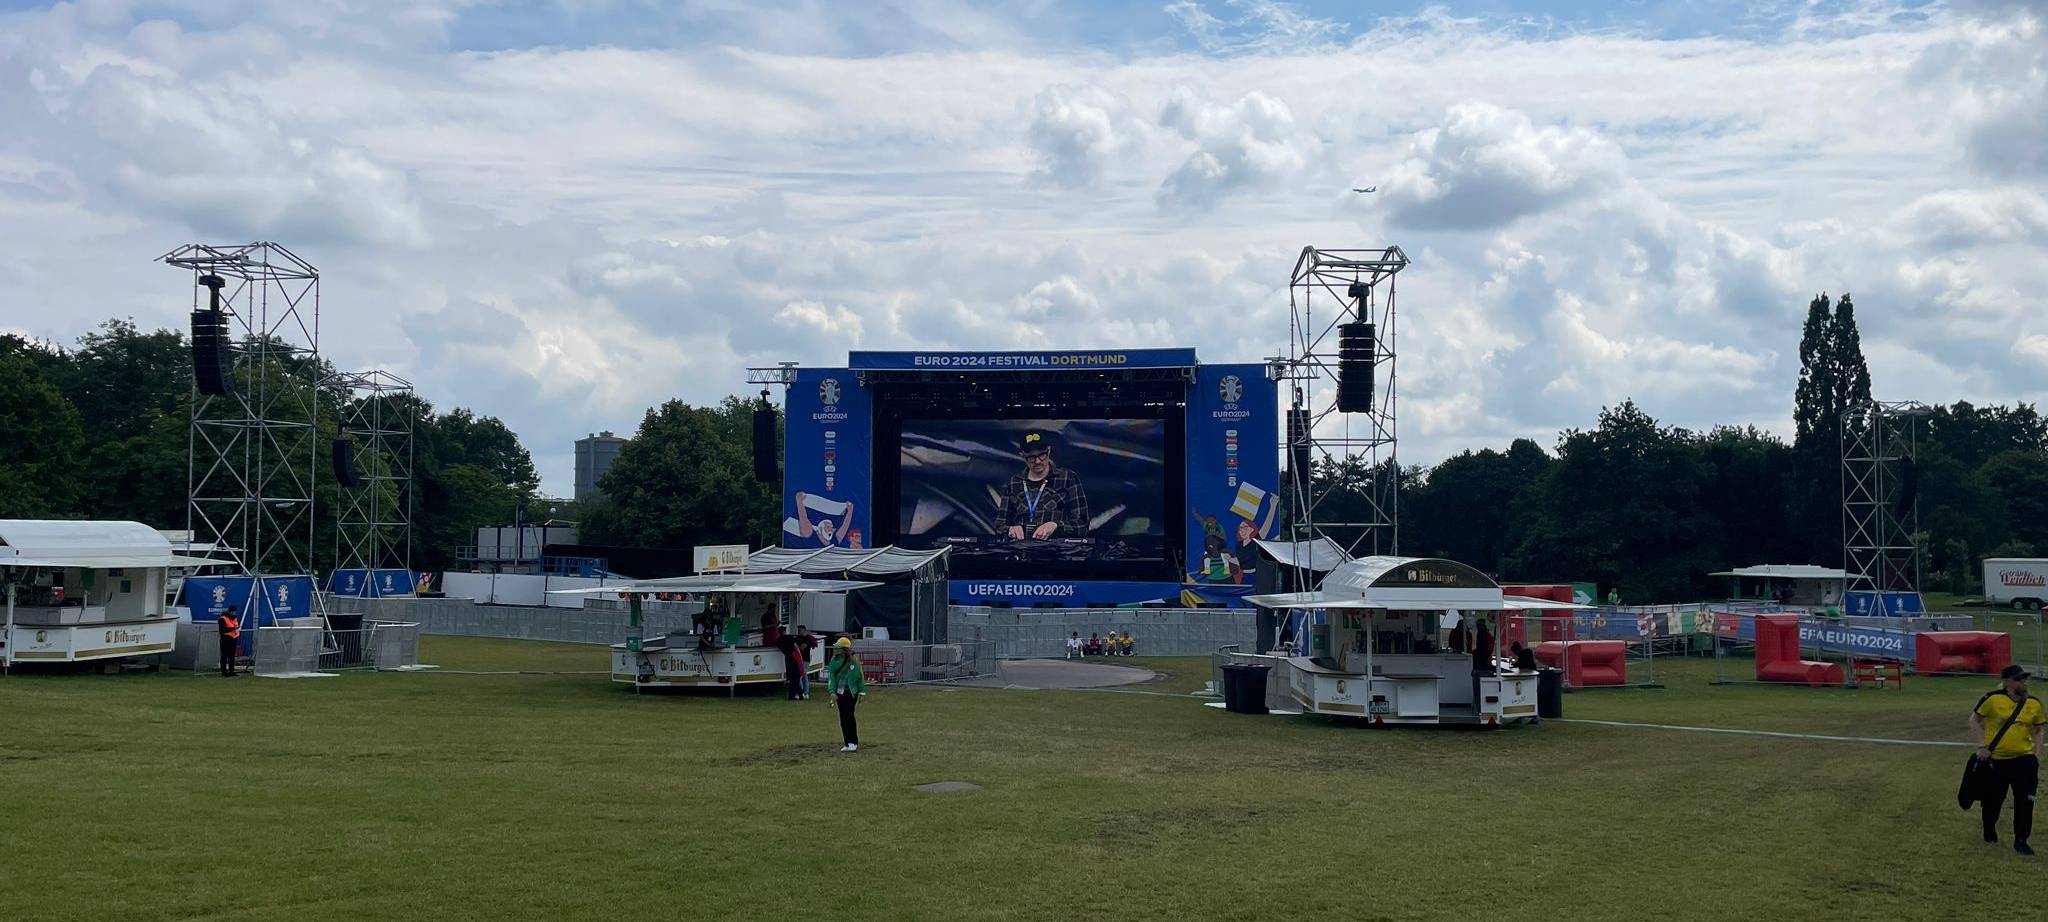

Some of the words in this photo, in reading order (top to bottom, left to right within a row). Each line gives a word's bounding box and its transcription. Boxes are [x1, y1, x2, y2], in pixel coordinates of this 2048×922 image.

[914, 355, 950, 366] EURO
[952, 355, 986, 366] 2024
[988, 355, 1048, 366] FESTIVAL
[1050, 354, 1127, 365] DORTMUND
[1212, 410, 1250, 418] EURO2024
[1418, 569, 1457, 584] Bitburger
[968, 584, 1074, 597] UEFAEURO2024
[112, 630, 146, 644] Bitburger
[1799, 627, 1903, 651] EFAEURO2024
[670, 656, 710, 673] Bitburger
